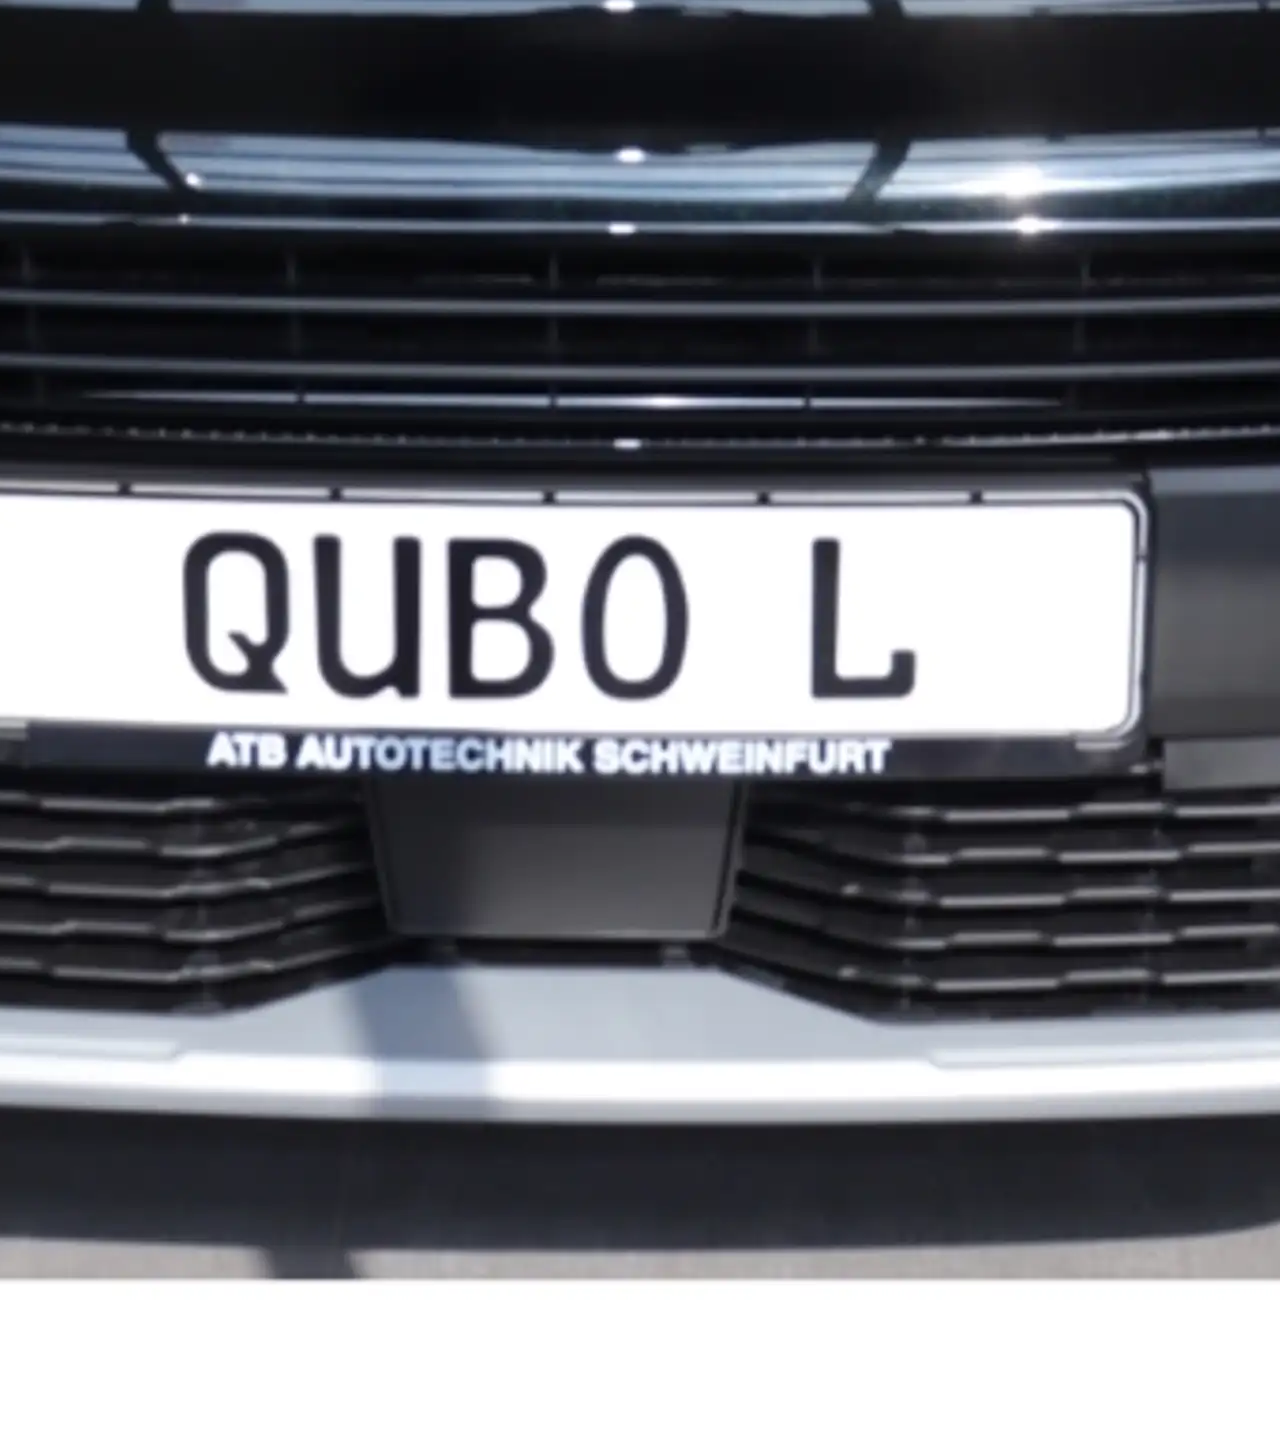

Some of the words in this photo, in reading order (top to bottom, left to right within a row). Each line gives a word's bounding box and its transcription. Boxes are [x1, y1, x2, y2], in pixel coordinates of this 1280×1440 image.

[183, 530, 689, 700] QUBO
[812, 538, 915, 699] L
[207, 731, 287, 769] ATB
[295, 733, 584, 773] AUTOTECHNIK
[593, 738, 892, 774] SCHWEINFURT
